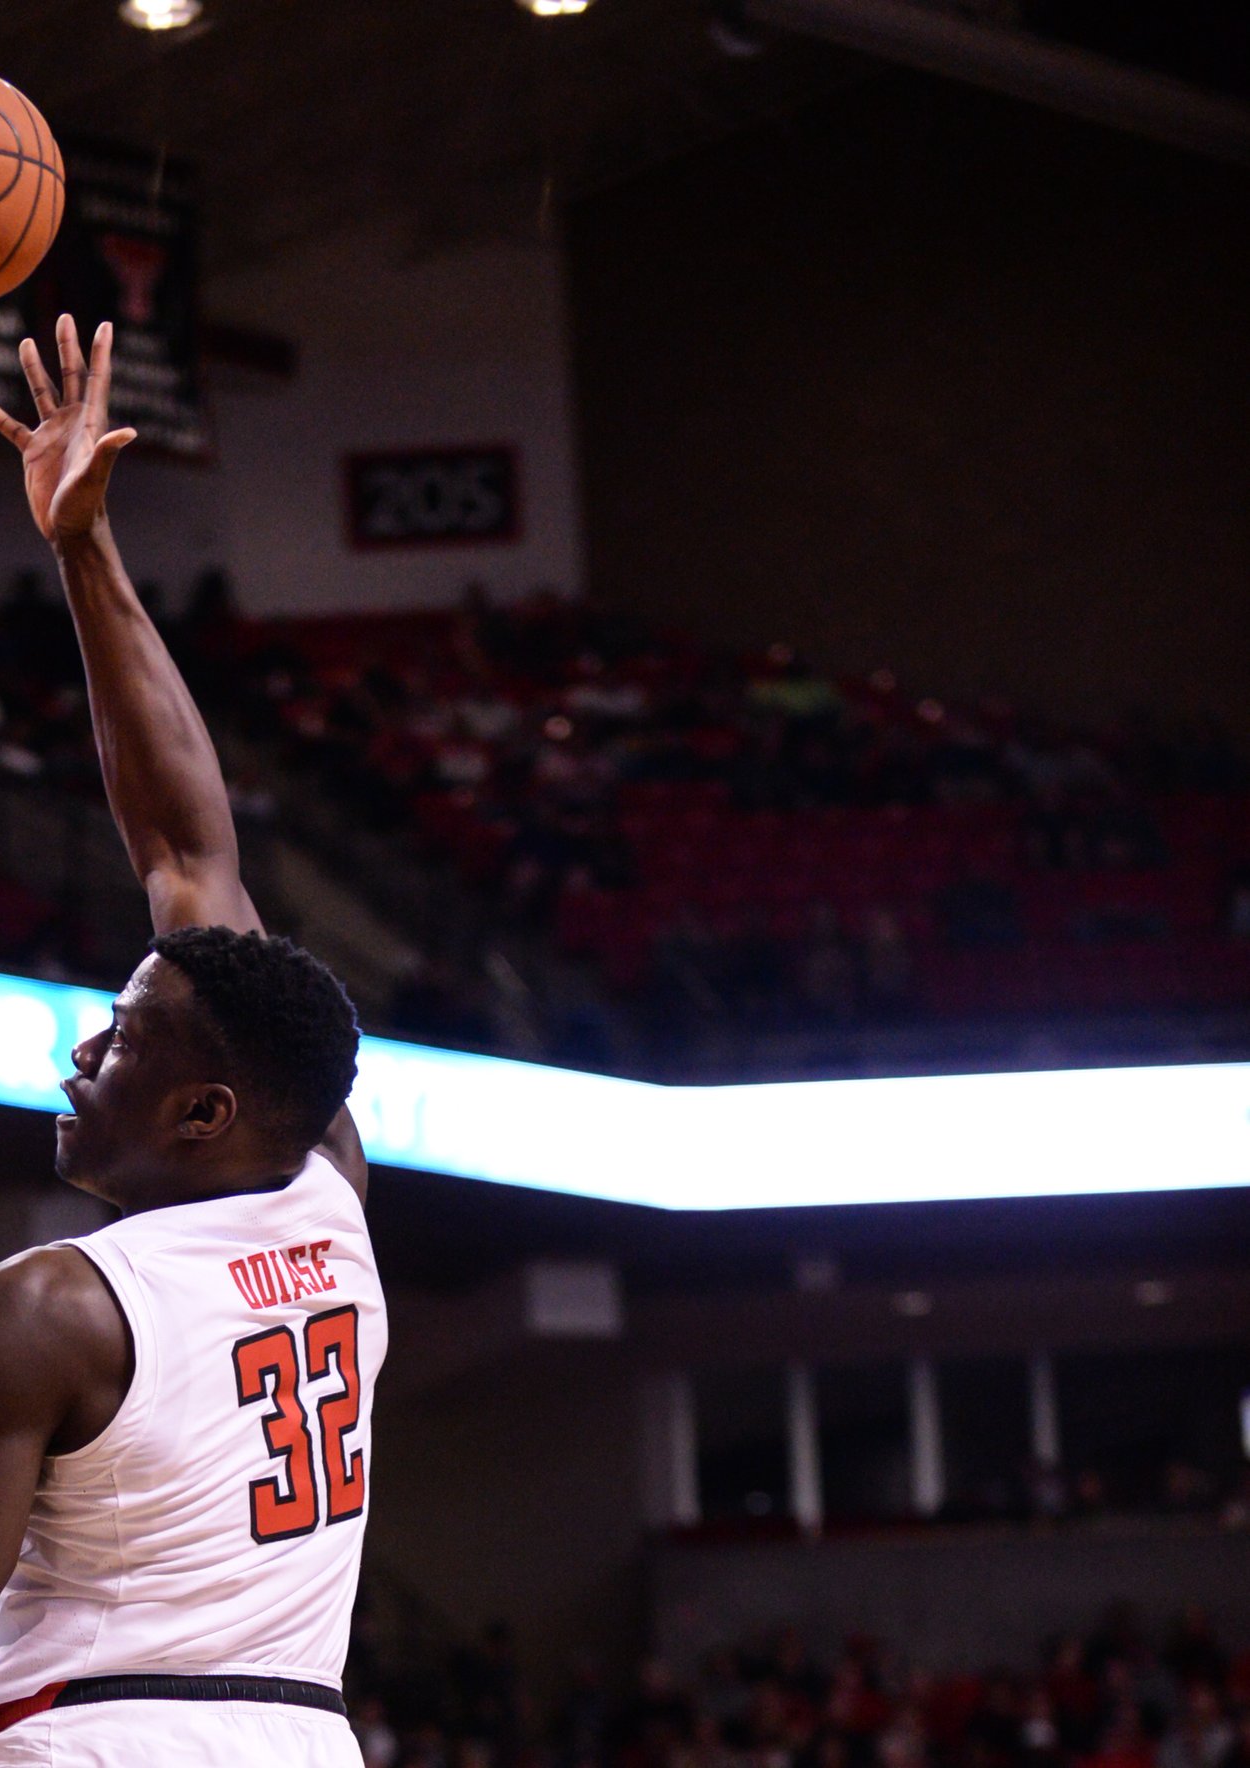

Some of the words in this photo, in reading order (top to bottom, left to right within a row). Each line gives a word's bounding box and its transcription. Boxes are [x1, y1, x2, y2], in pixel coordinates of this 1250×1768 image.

[361, 457, 505, 536] 205
[228, 1240, 337, 1309] ODIASE
[231, 1304, 364, 1544] 32
